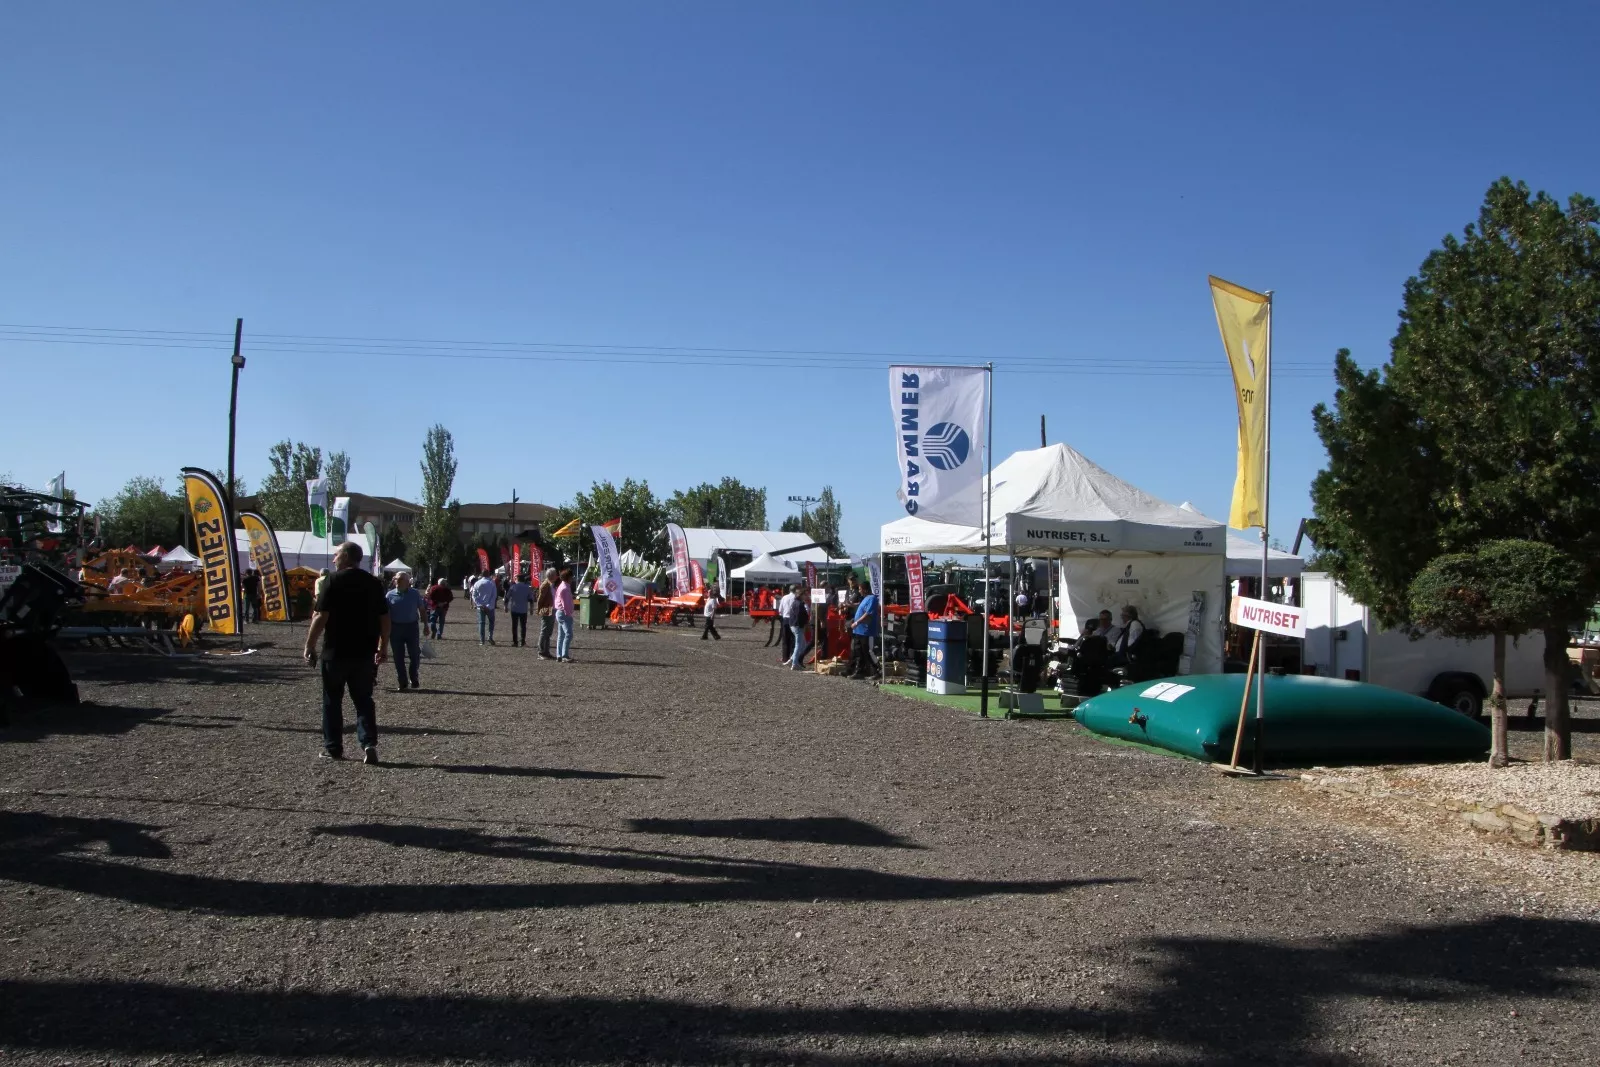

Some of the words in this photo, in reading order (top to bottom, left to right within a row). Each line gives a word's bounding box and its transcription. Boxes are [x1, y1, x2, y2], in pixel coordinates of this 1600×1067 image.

[1027, 529, 1087, 543] NUTRISET,
[1090, 533, 1110, 543] S.L.
[1242, 604, 1300, 629] NUTRISET
